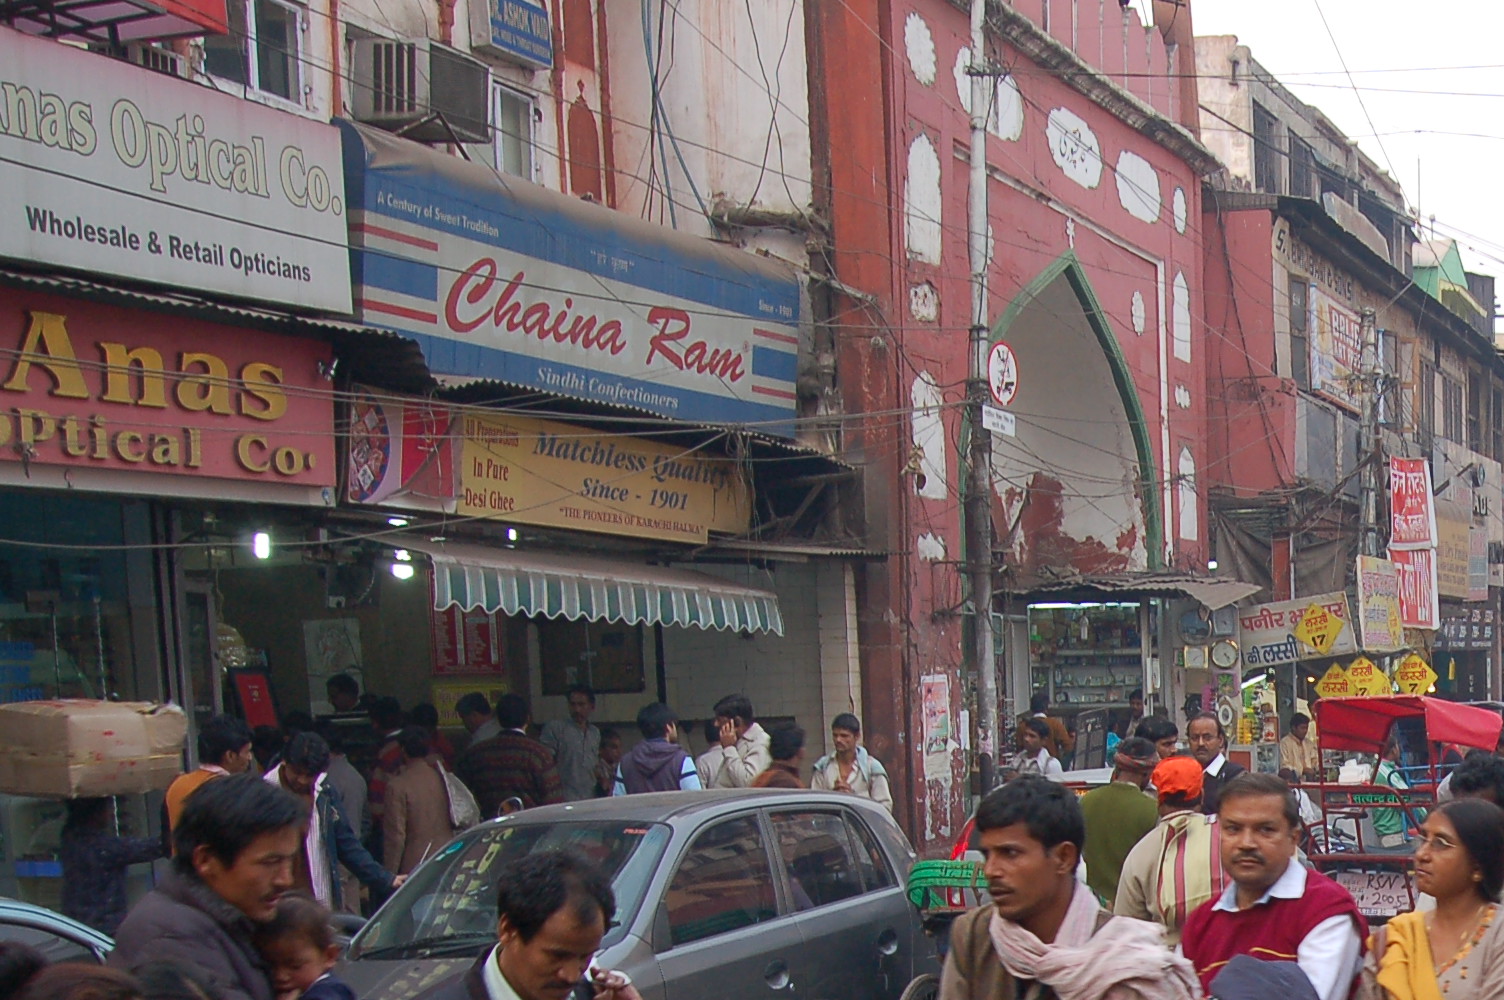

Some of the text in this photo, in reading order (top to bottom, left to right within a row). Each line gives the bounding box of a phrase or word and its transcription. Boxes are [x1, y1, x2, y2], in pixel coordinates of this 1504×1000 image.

[0, 82, 342, 216] nas Optical Co.
[377, 190, 499, 238] A Century of Sweet Tradition
[26, 205, 311, 282] Wholesale & Retail Opticians
[445, 257, 745, 383] Chaina Ram
[3, 311, 288, 421] Anas
[537, 367, 680, 410] Sindhi Confectioners
[473, 456, 509, 482] In Pure
[532, 432, 647, 473] Matchless
[465, 487, 515, 512] Desi Ghee
[580, 477, 629, 502] Since
[649, 488, 689, 511] 1901
[583, 509, 623, 524] PIONEERS
[624, 513, 635, 525] OF
[1241, 608, 1284, 632] पनीर
[1262, 634, 1299, 661] लस्सी
